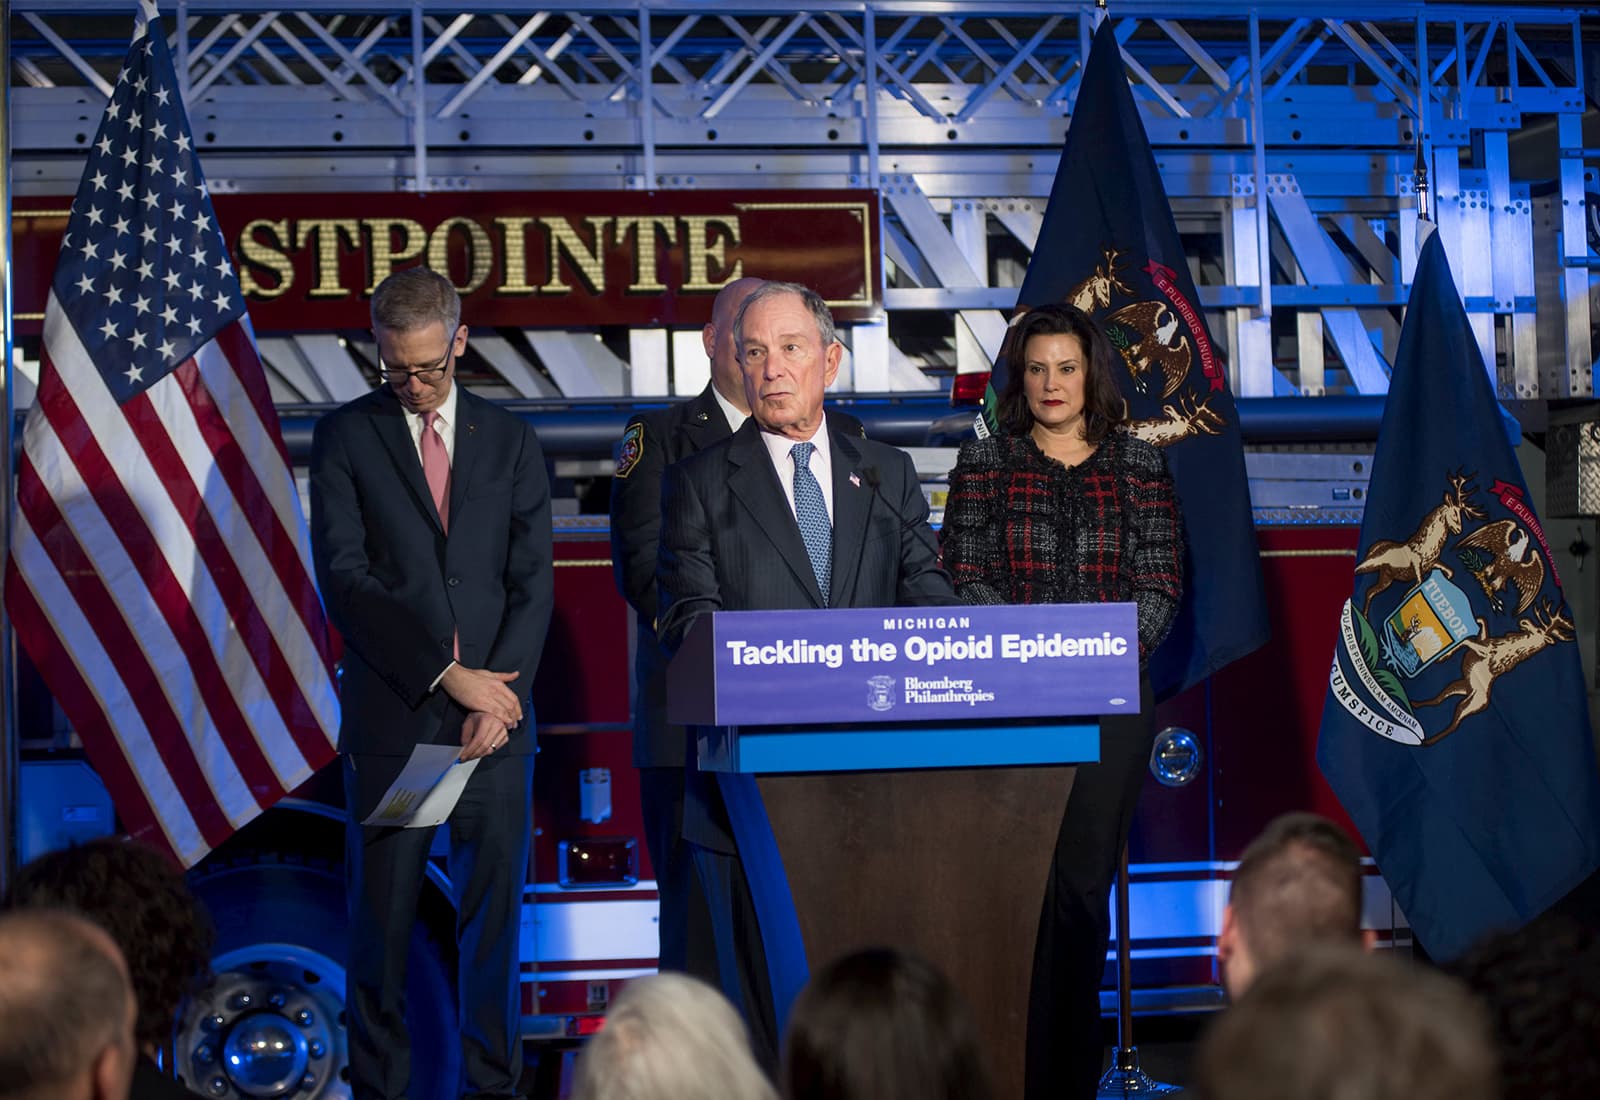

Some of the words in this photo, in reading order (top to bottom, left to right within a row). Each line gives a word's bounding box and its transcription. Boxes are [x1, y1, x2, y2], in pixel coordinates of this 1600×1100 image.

[238, 215, 743, 297] STPOINTE
[1157, 279, 1167, 289] E
[1165, 287, 1201, 335] PLURIBUS
[1196, 335, 1213, 371] UNUM
[1505, 497, 1515, 506] E
[883, 616, 970, 630] MICHIGAN
[1425, 579, 1469, 639] TUEBOR
[726, 638, 844, 669] Tackling
[849, 637, 898, 662] the
[903, 634, 994, 666] Opioid
[1000, 631, 1128, 664] Epidemic
[903, 675, 974, 691] Bloomberg
[903, 687, 995, 707] Philanthropies
[1331, 664, 1394, 736] CUMSPICE
[1353, 650, 1387, 704] PENINSULAM
